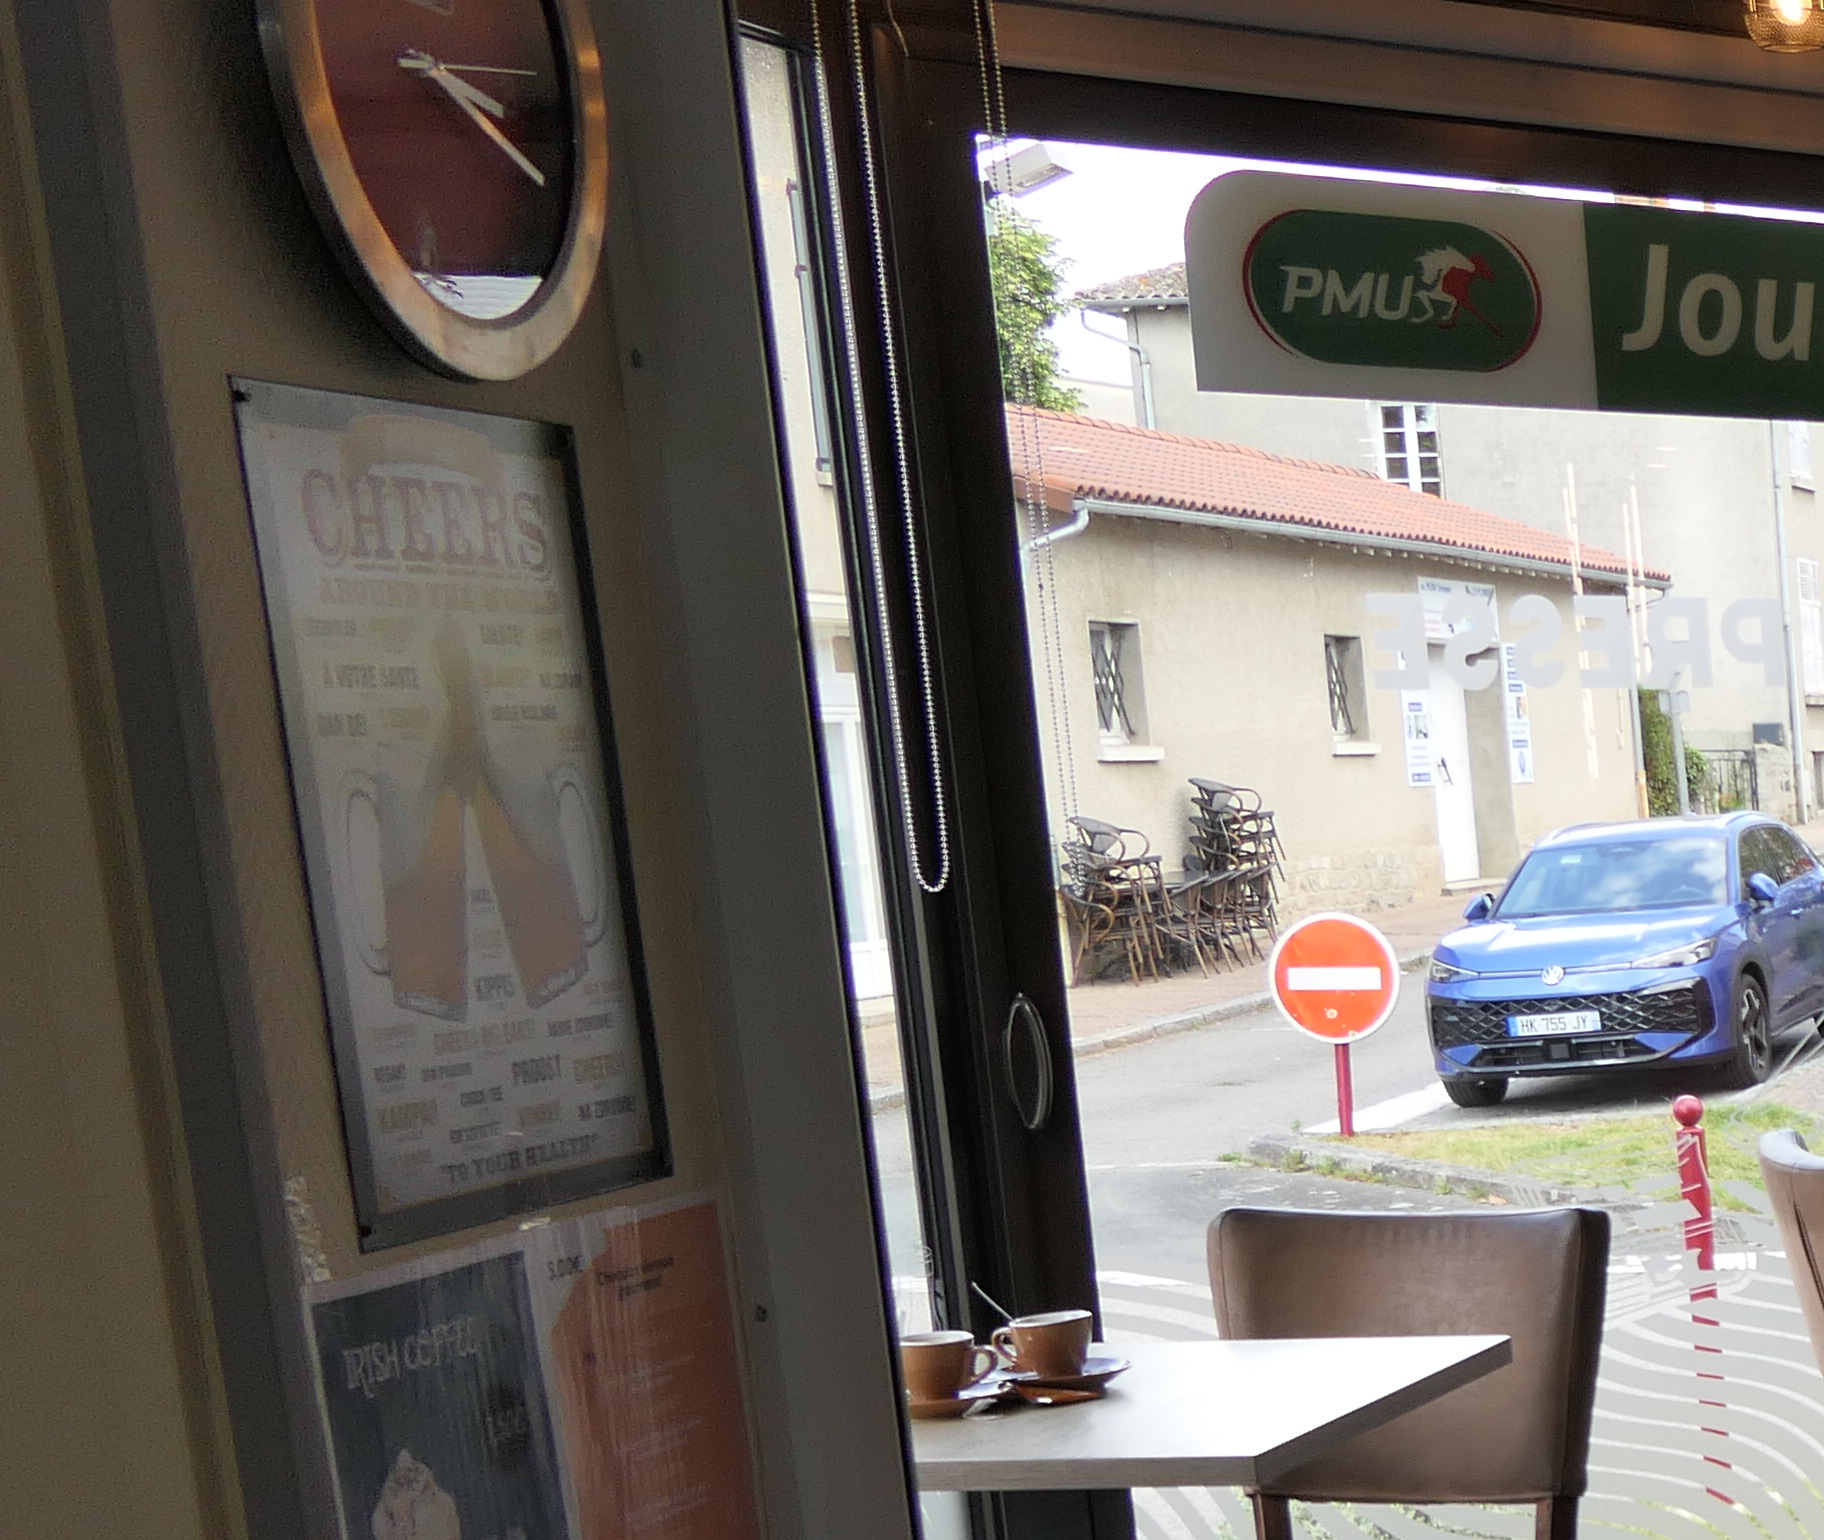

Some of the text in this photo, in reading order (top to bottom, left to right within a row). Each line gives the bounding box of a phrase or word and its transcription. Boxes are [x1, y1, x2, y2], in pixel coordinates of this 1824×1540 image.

[1280, 266, 1414, 321] PMU
[300, 467, 548, 574] CHEERS
[1521, 1015, 1588, 1033] HK 755 JY
[342, 1339, 401, 1400] IRISH
